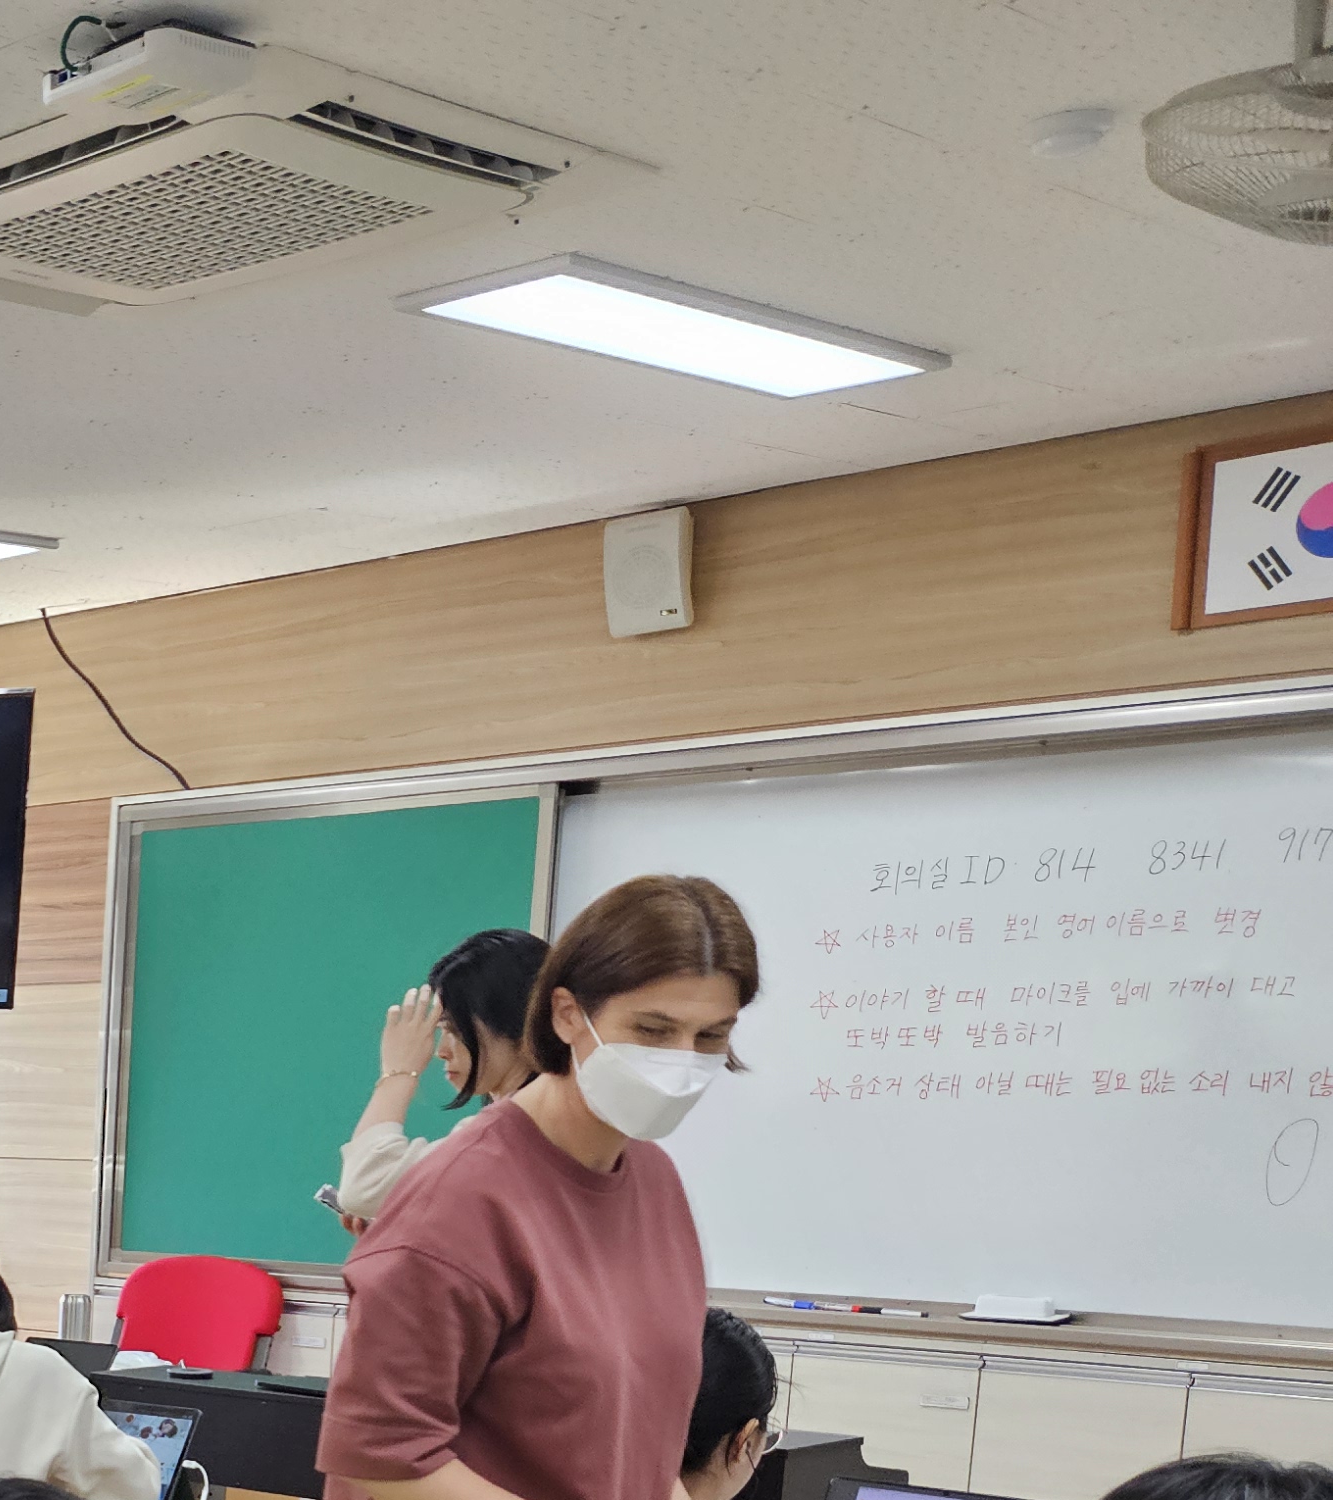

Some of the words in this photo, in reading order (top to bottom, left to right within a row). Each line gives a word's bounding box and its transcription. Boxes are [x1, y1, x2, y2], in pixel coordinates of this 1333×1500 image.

[870, 857, 949, 895] 회의실
[960, 854, 1006, 885] ID
[1034, 847, 1095, 882] 814
[1149, 838, 1226, 875] 8341
[855, 923, 919, 949] 사용자
[935, 917, 974, 944] 이름
[1004, 914, 1039, 942] 본인
[1057, 913, 1095, 939] 영어
[1106, 908, 1190, 937] 이름으로
[1214, 907, 1262, 938] 변경
[845, 987, 910, 1013] 이야기
[925, 984, 946, 1013] 할
[956, 987, 986, 1011] 때
[1010, 981, 1091, 1006] 마이크를
[1110, 978, 1151, 1006] 입에
[1168, 976, 1234, 998] 가까이
[1250, 976, 1296, 997] 대고
[966, 1021, 1063, 1048] 발음하기
[845, 1073, 903, 1100] 음소거
[914, 1072, 962, 1100] 상태
[975, 1071, 1014, 1096] 아닐
[1025, 1071, 1073, 1097] 때는
[1092, 1068, 1132, 1095] 필요
[1140, 1068, 1176, 1095] 없는
[1189, 1069, 1230, 1097] 소리
[1249, 1067, 1294, 1094] 내지
